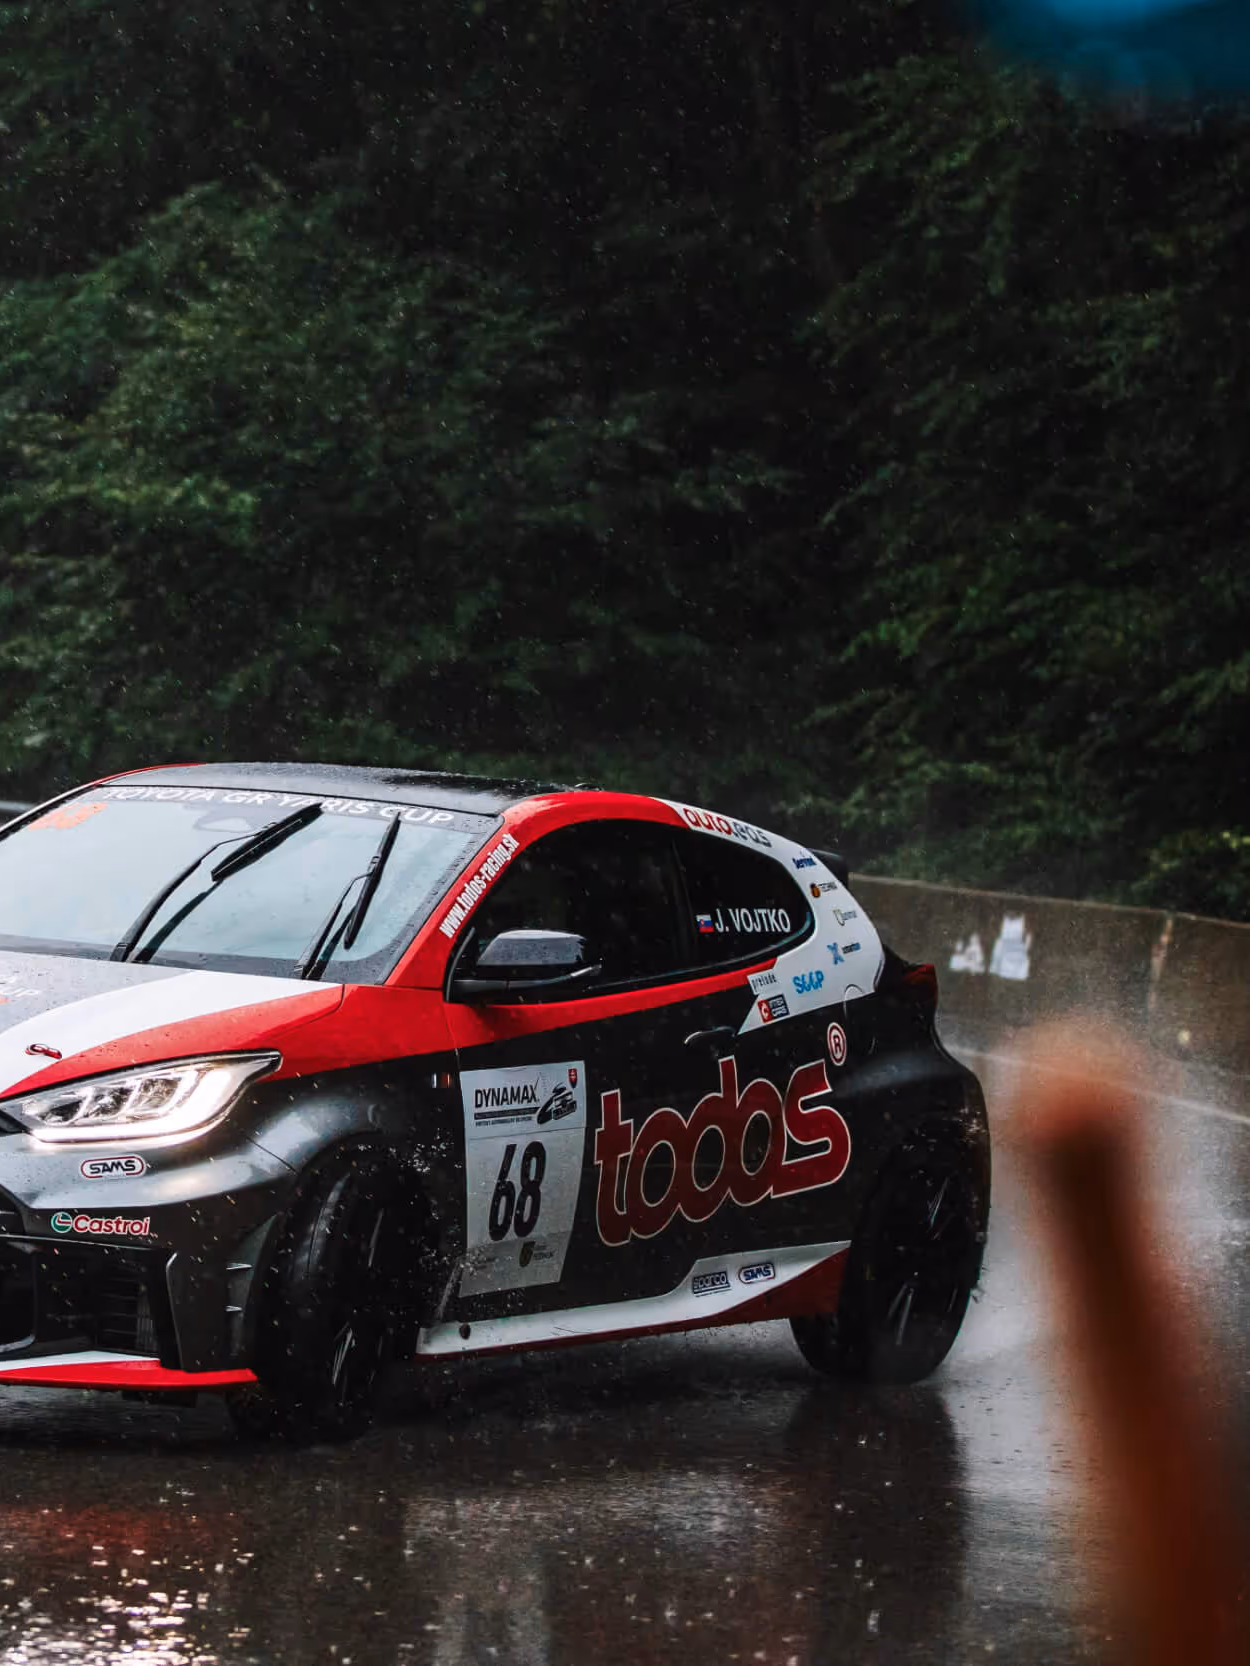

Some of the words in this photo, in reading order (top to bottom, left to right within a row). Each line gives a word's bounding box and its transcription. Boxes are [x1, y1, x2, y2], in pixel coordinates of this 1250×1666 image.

[223, 792, 272, 806] GR
[379, 803, 455, 824] CUP
[439, 833, 520, 938] www.todos-racing.sk
[715, 908, 730, 933] J.
[728, 908, 791, 933] VOJTKO
[475, 1084, 539, 1108] DYNAMAX
[90, 1160, 137, 1175] SAMS
[488, 1141, 547, 1242] 68
[73, 1214, 150, 1236] Castrol
